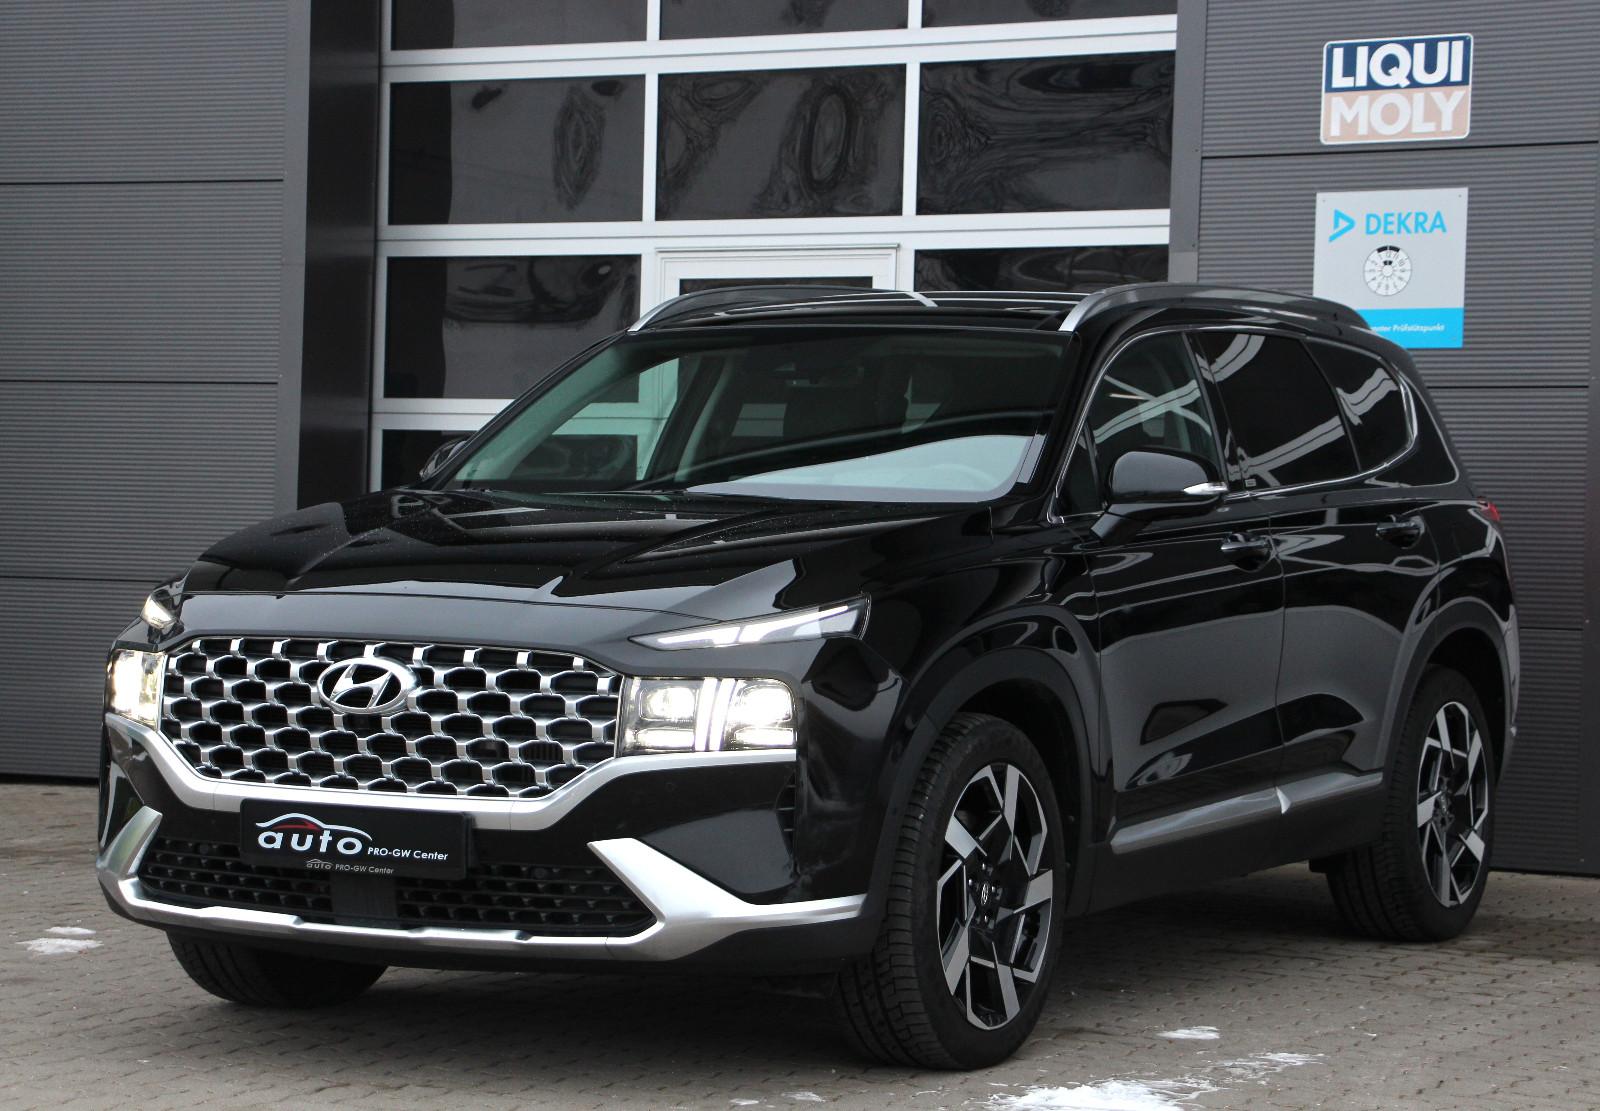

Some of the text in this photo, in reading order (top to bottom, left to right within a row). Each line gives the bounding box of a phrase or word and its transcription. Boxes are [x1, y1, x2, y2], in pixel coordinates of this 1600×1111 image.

[1331, 40, 1464, 88] LIQUI
[1330, 90, 1466, 137] MOLY
[1365, 210, 1447, 236] DEKRA
[257, 829, 449, 861] auto PRO-GW Center
[306, 862, 332, 870] auto
[368, 866, 394, 874] Center
